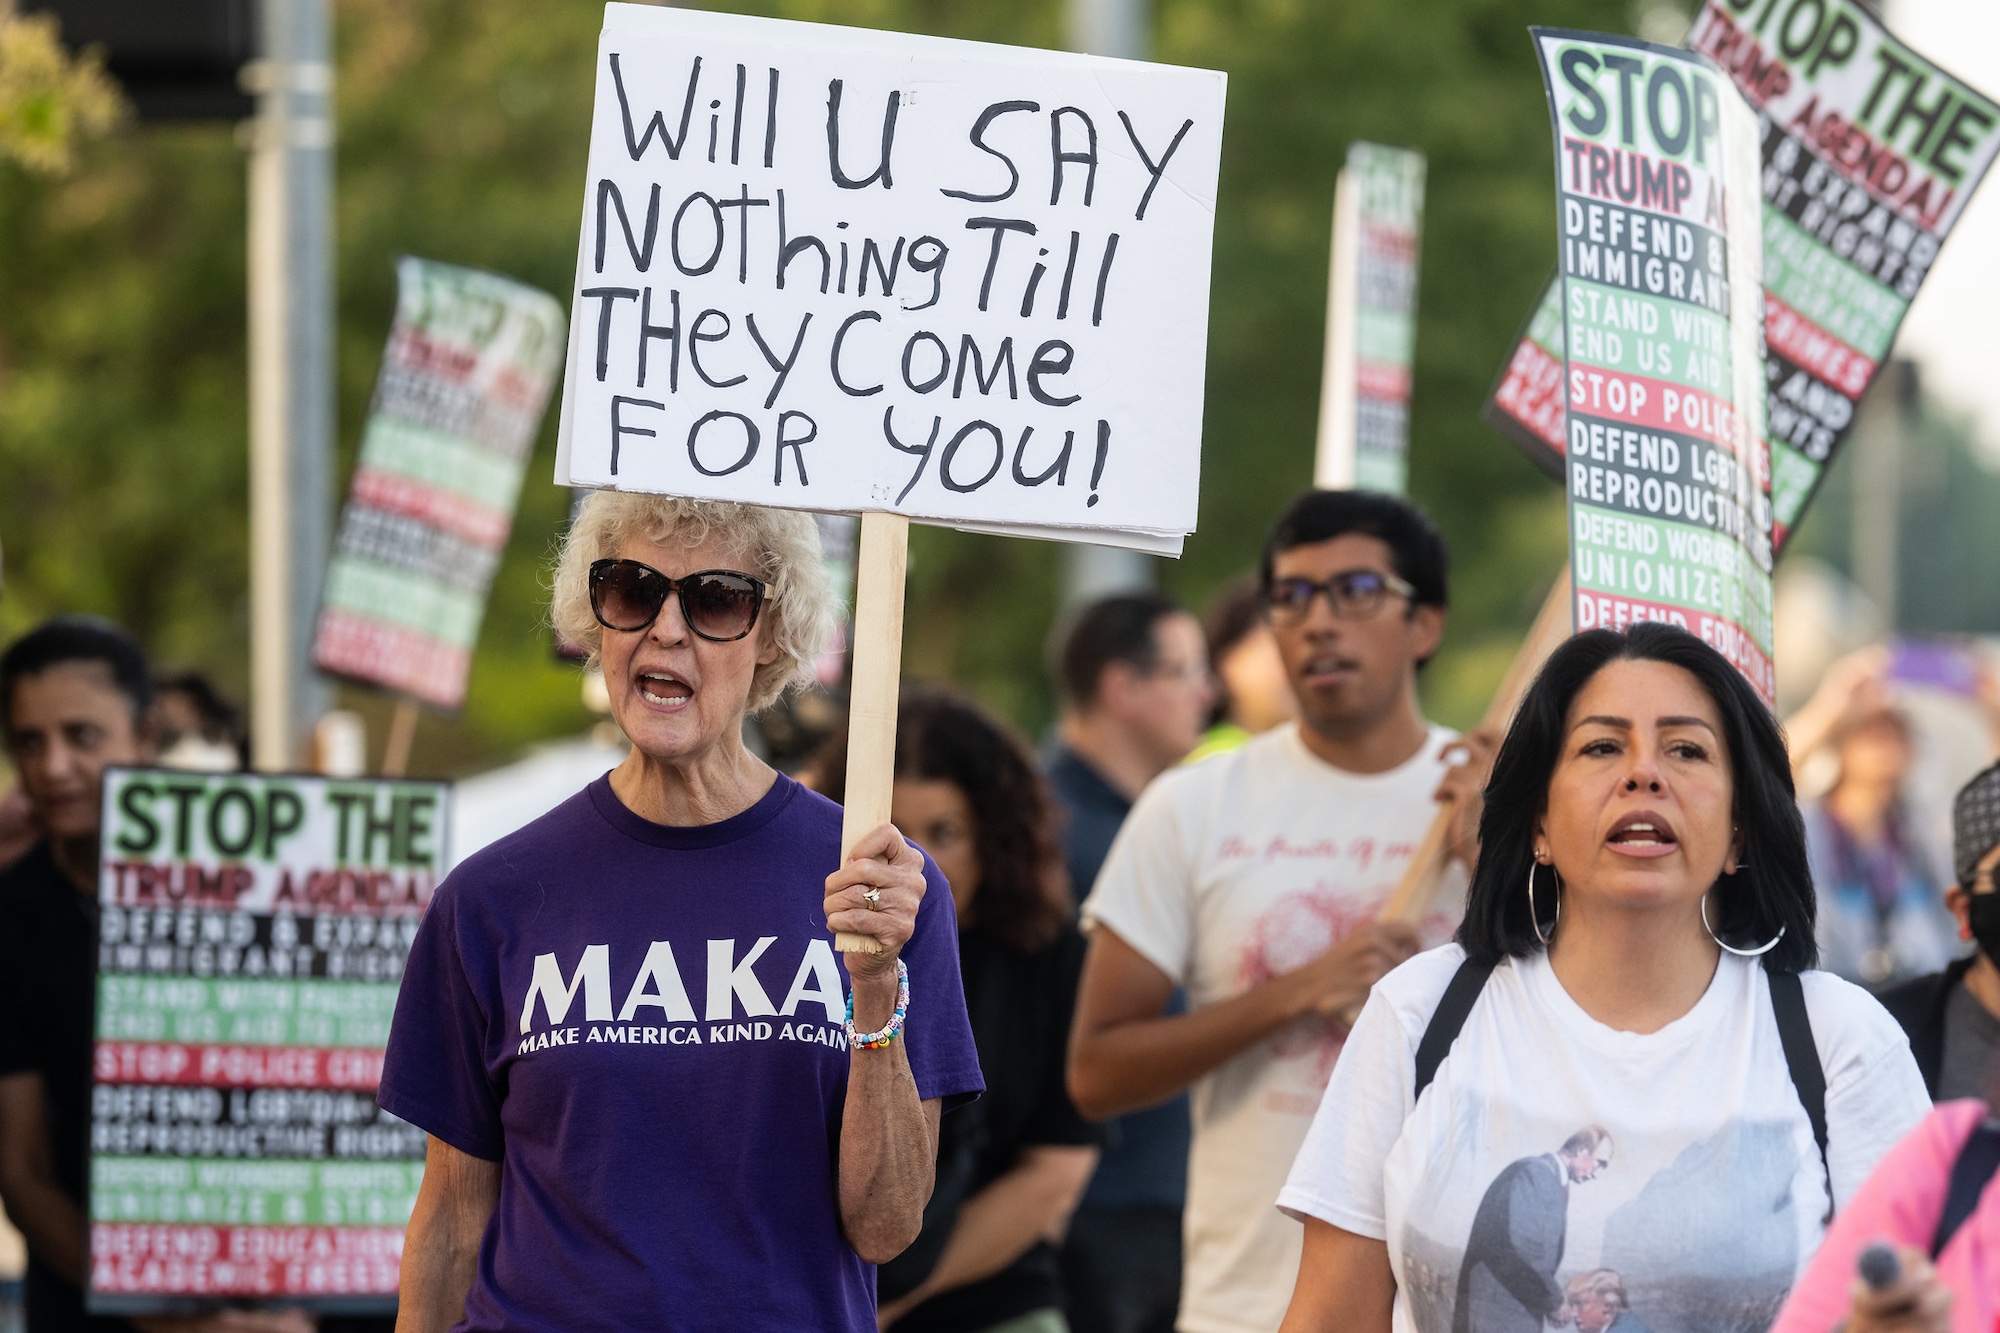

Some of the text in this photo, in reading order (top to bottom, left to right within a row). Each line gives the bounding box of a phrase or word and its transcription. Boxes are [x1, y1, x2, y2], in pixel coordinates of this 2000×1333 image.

[609, 53, 1194, 221] Will U SAY
[1557, 44, 1719, 170] STOP
[1698, 6, 1791, 106] TRUMP
[1788, 94, 1955, 230] AGENDA!
[1857, 42, 1996, 184] THE
[1564, 136, 1692, 215] TRUMP
[1565, 198, 1694, 262] DEFEND
[1707, 236, 1722, 274] &
[1800, 194, 1925, 298] RIGHTS
[1801, 160, 1939, 268] EXPAND
[964, 217, 1120, 327] Till
[1571, 286, 1659, 335] STAND
[1671, 308, 1723, 354] WITH
[1571, 324, 1623, 365] END
[1637, 338, 1673, 375] US
[1686, 350, 1721, 389] AID
[1569, 369, 1647, 416] STOP
[610, 394, 818, 487] FOR
[1571, 419, 1680, 475] DEFEND
[1575, 509, 1659, 555] DEFEND
[1577, 547, 1722, 609] UNIONIZE
[114, 781, 437, 866] STOP THE
[109, 862, 256, 907] TRUMP
[100, 910, 256, 947] DEFEND
[519, 936, 844, 1036] MAKA
[94, 1043, 189, 1081] STOP
[200, 1047, 320, 1085] POLICE
[517, 1026, 579, 1056] MAKE
[586, 1026, 702, 1045] AMERICA
[709, 1023, 772, 1044] KIND
[779, 1022, 847, 1052] AGAIN
[91, 1084, 223, 1123] DEFEND
